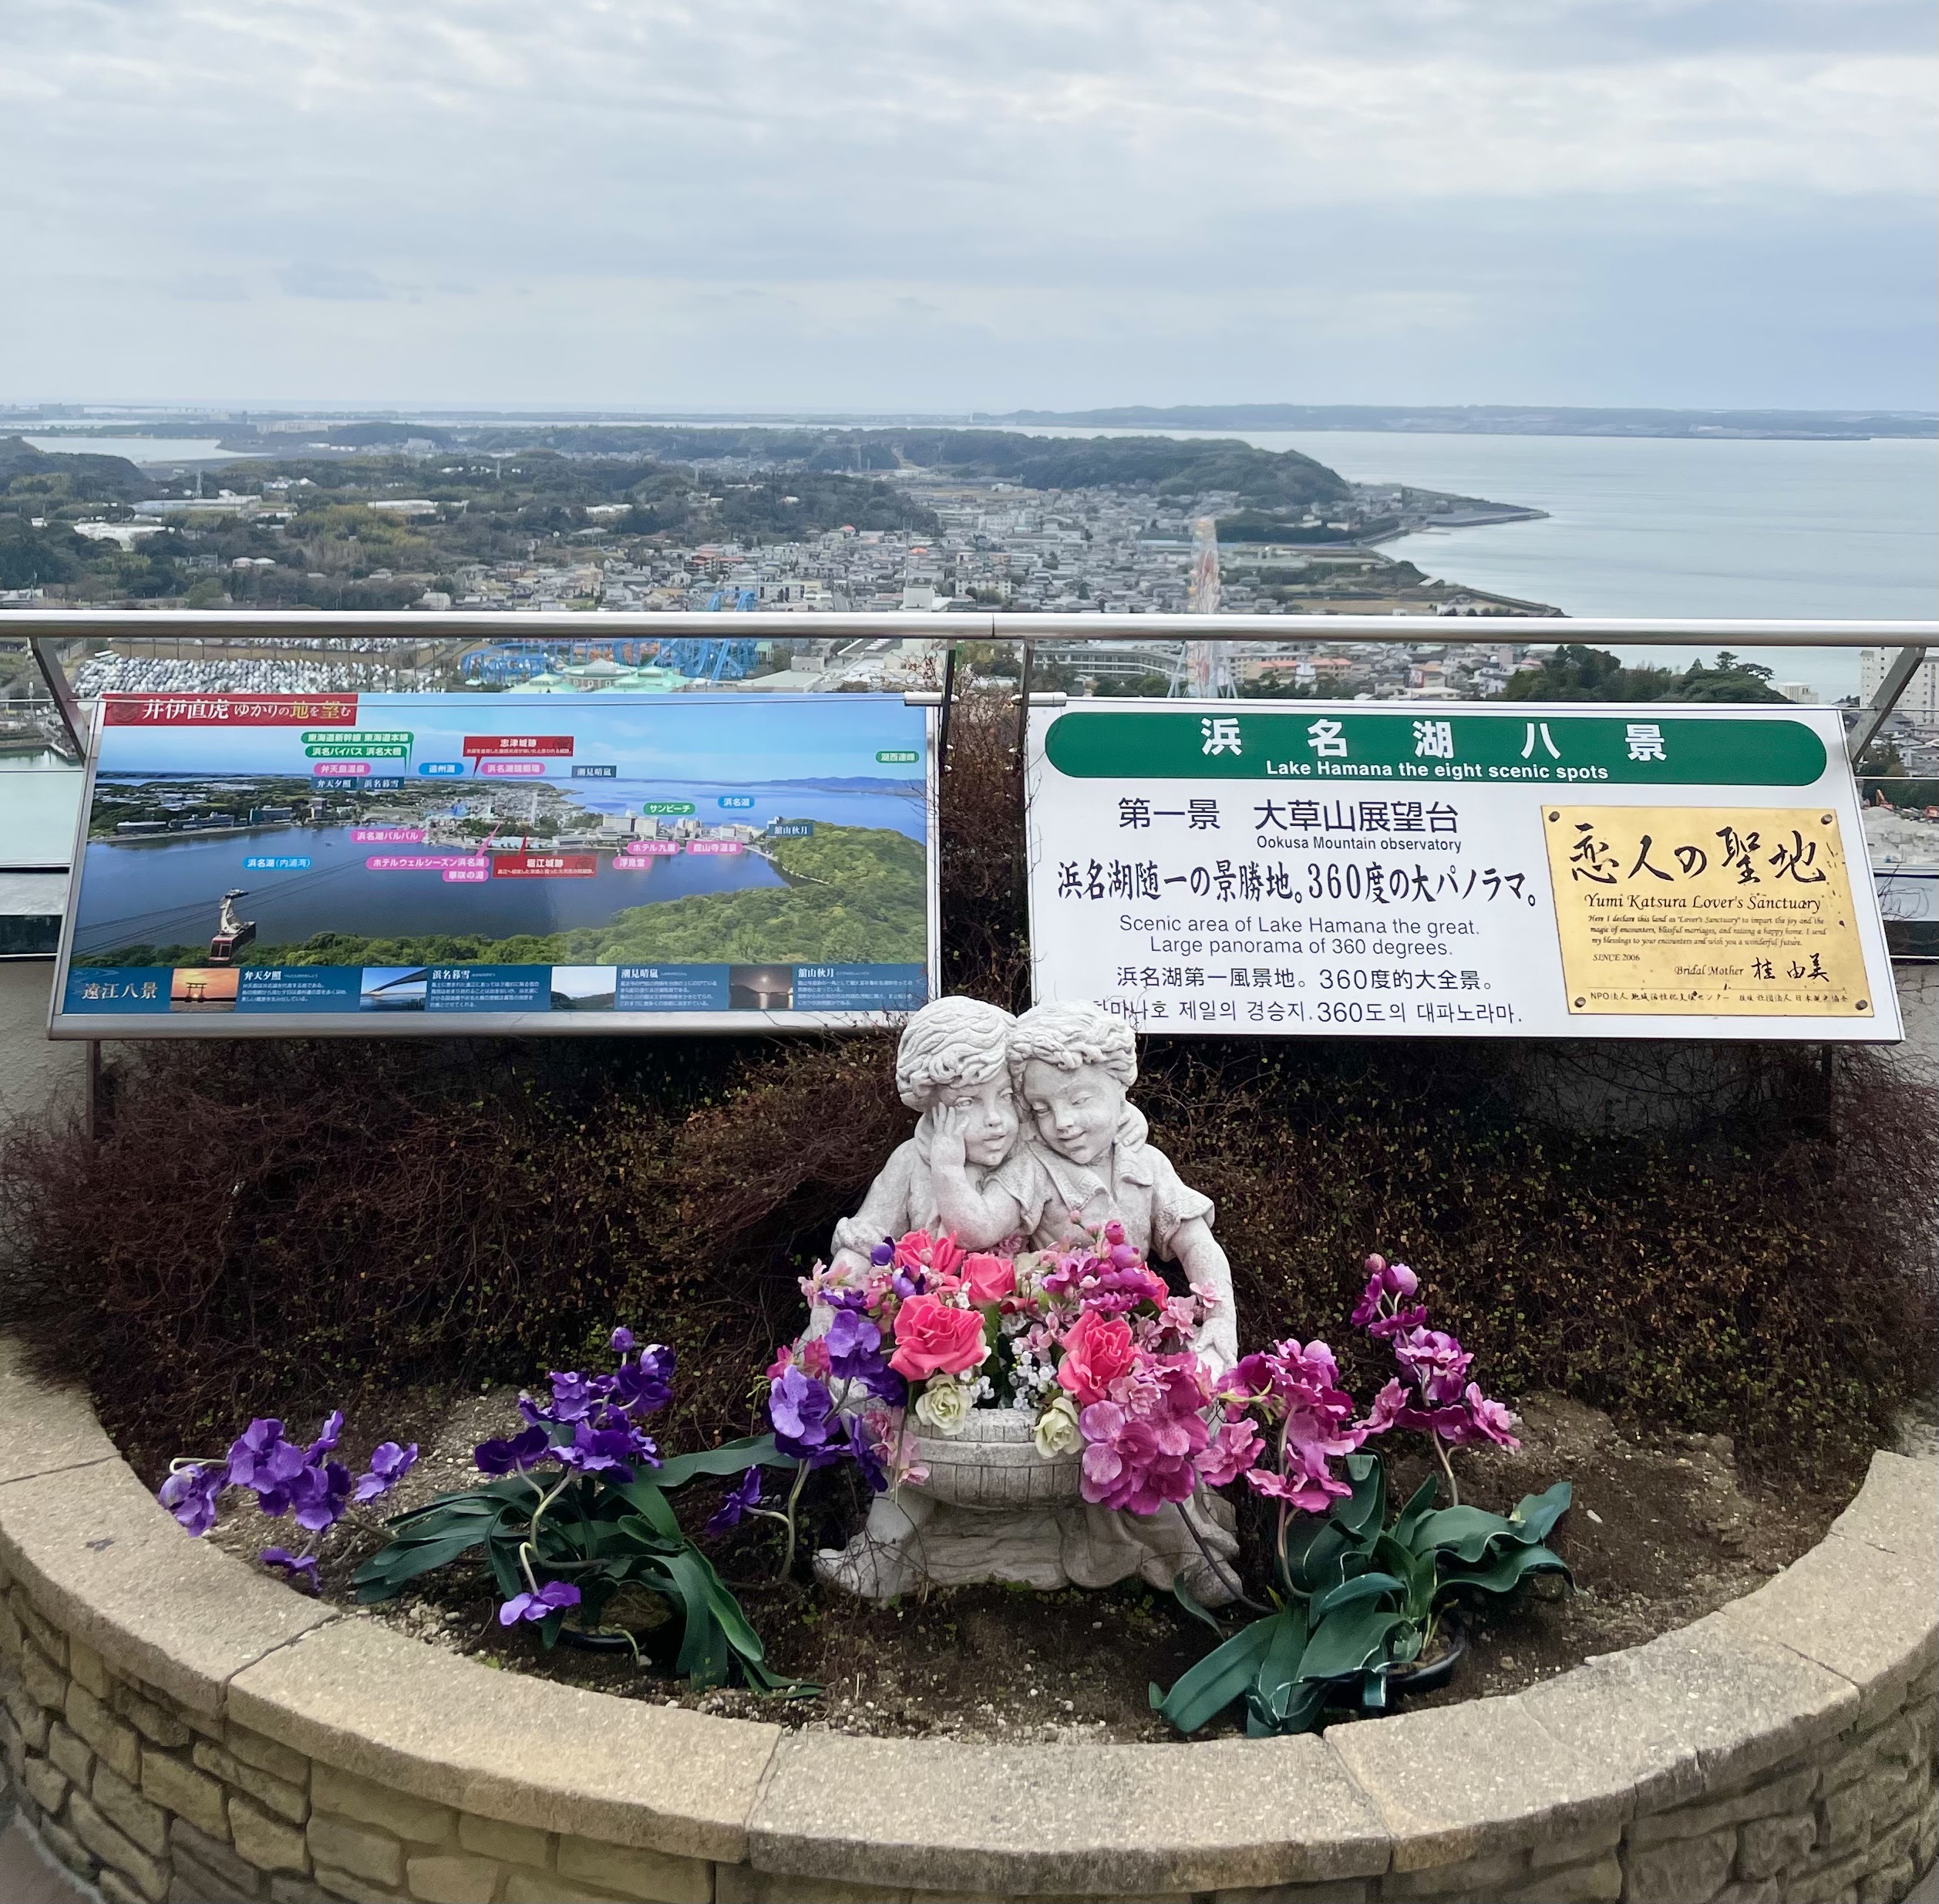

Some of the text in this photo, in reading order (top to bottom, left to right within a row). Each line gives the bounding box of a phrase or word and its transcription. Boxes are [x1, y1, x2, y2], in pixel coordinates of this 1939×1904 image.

[142, 698, 352, 720] 井伊直虎ゆかりの地を望む
[1200, 717, 1667, 761] 浜名湖八景
[312, 747, 402, 756] 浜名バイパス 浜名大橋
[1266, 760, 1608, 782] Lake Hamana the eight scenic spots
[649, 804, 691, 813] サンビーチ
[723, 797, 750, 807] 浜名湖
[1118, 797, 1459, 834] 第一景 大草山展望台
[356, 831, 419, 841] 浜名湖パルパル
[633, 843, 676, 853] ホテル九重
[1256, 835, 1462, 854] Ookusa Mountain observatory
[1569, 823, 1827, 885] 恋人の聖地
[373, 858, 485, 868] ホテルウェルシーズン浜名湖
[1584, 893, 1821, 914] Yumi Katsura Lover's Sanctuary
[1119, 915, 1479, 939] Scenic area of Lake Hamana the great.
[1787, 917, 1797, 926] joy
[1813, 916, 1824, 925] the
[1611, 925, 1618, 935] of
[1763, 927, 1783, 937] happy
[1812, 927, 1827, 935] send
[1150, 935, 1453, 959] Large panorama of 360 degrees.
[1603, 936, 1631, 945] blessings
[1708, 937, 1723, 945] wish
[1745, 938, 1778, 948] wonderful
[1593, 953, 1641, 962] SINCE 2006
[1674, 965, 1745, 976] Bridal Mother
[1751, 952, 1830, 982] 桂 由美
[244, 970, 281, 981] 弁天夕照
[82, 981, 159, 1001] 遠江八景
[1179, 999, 1237, 1021] 제일의
[1417, 1002, 1522, 1024] 대파노라마.
